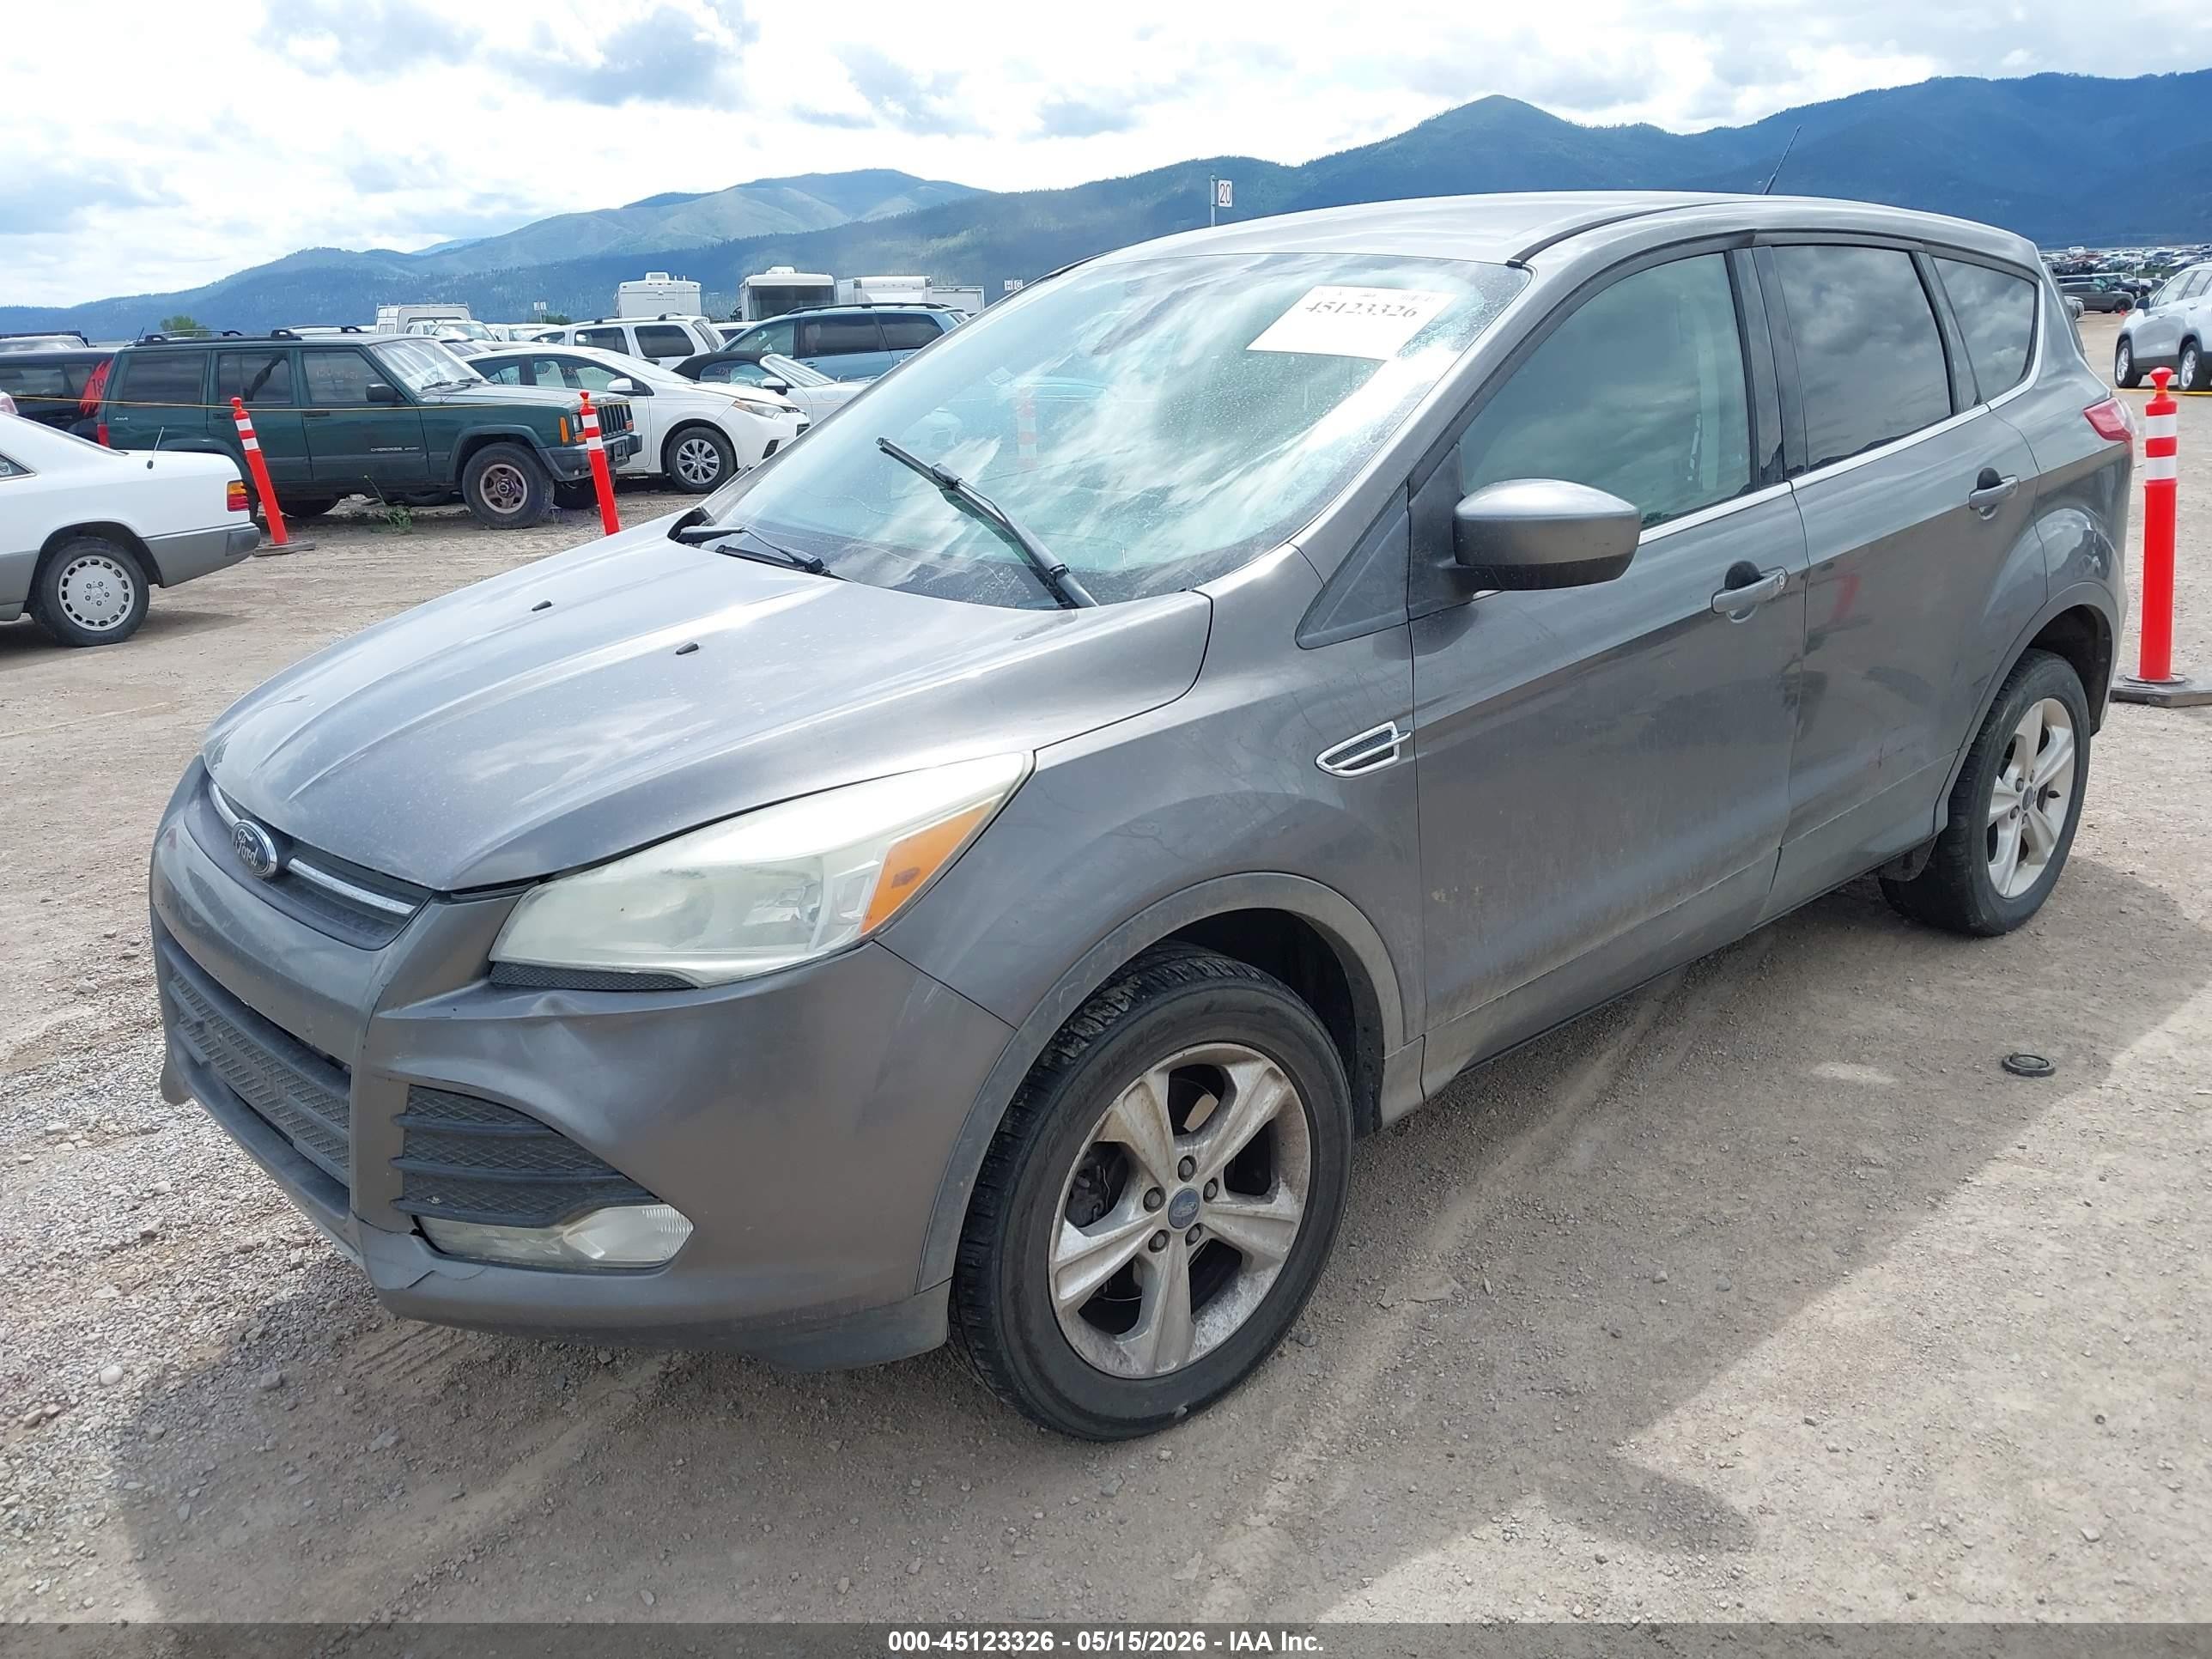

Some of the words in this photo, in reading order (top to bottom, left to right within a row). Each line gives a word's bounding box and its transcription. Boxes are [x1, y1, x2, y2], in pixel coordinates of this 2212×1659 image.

[1220, 183, 1231, 204] 20
[1006, 281, 1012, 289] H
[1015, 280, 1022, 289] G
[1305, 301, 1418, 318] 45123326
[235, 828, 258, 866] Ford
